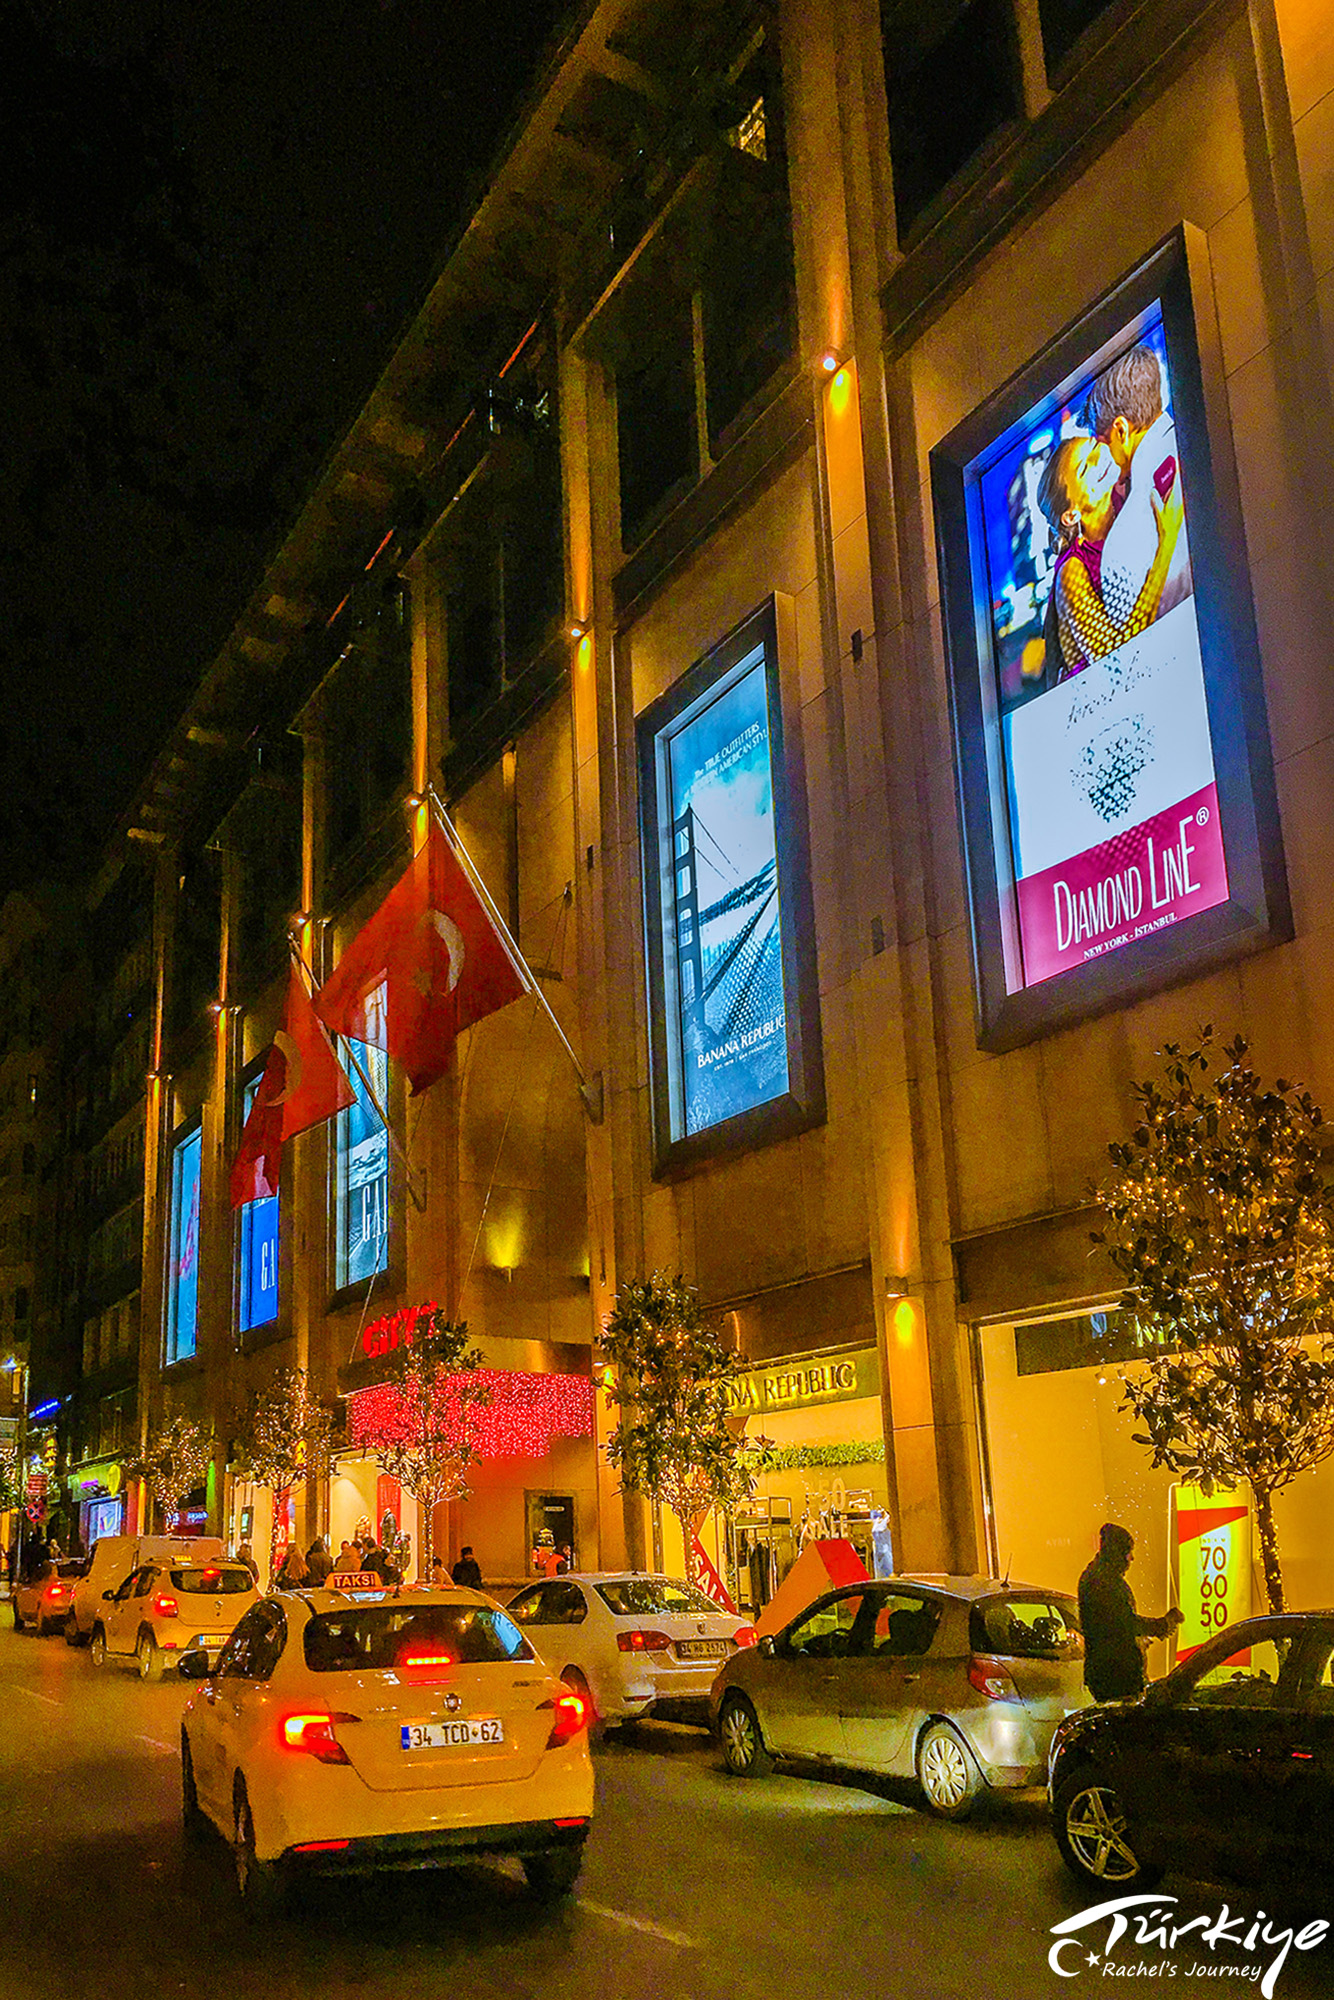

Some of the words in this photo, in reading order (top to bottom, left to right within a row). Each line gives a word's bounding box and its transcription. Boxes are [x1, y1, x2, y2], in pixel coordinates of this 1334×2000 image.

[721, 720, 761, 759] OUTFITTERS
[718, 740, 753, 774] AMERICAN
[1053, 866, 1143, 952] DIAMOND
[1083, 943, 1105, 960] NEW
[1104, 933, 1129, 951] YORK
[697, 1040, 740, 1069] BANANA
[740, 1013, 786, 1049] REPUBLIC
[763, 1362, 854, 1402] REPUBLIC
[1200, 1546, 1227, 1571] 70
[1200, 1574, 1228, 1599] 60
[1200, 1602, 1228, 1627] 50
[412, 1728, 432, 1747] 34
[442, 1723, 470, 1745] TCD
[481, 1722, 500, 1741] 62
